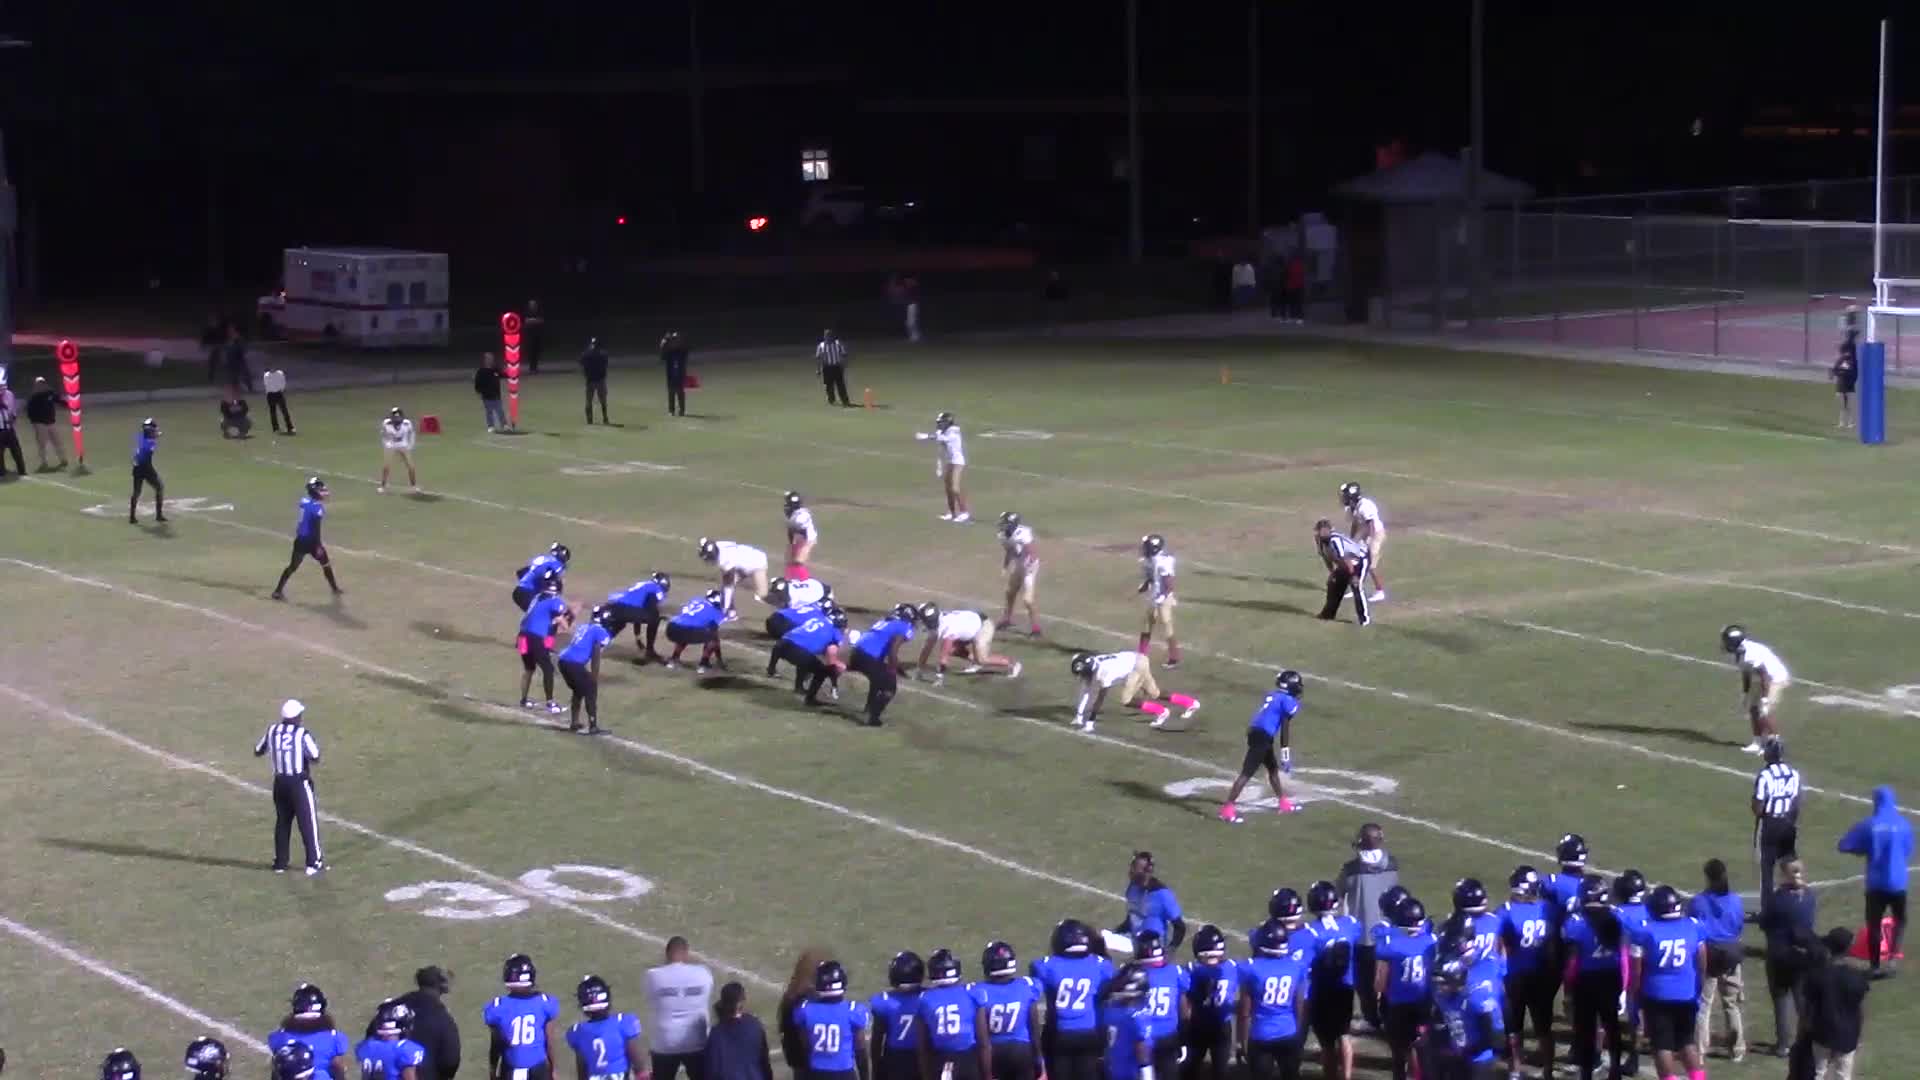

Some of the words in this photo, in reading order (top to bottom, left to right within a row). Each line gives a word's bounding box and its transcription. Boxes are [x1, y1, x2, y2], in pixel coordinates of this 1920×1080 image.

[1163, 767, 1399, 813] 20
[383, 864, 656, 920] 30
[1658, 938, 1687, 969] 75
[1055, 977, 1092, 1011] 62
[1263, 975, 1293, 1006] 88
[511, 1014, 536, 1046] 16
[897, 1014, 914, 1041] 7
[935, 1003, 961, 1035] 15
[989, 1001, 1021, 1033] 67
[592, 1037, 609, 1069] 2
[813, 1023, 841, 1053] 20
